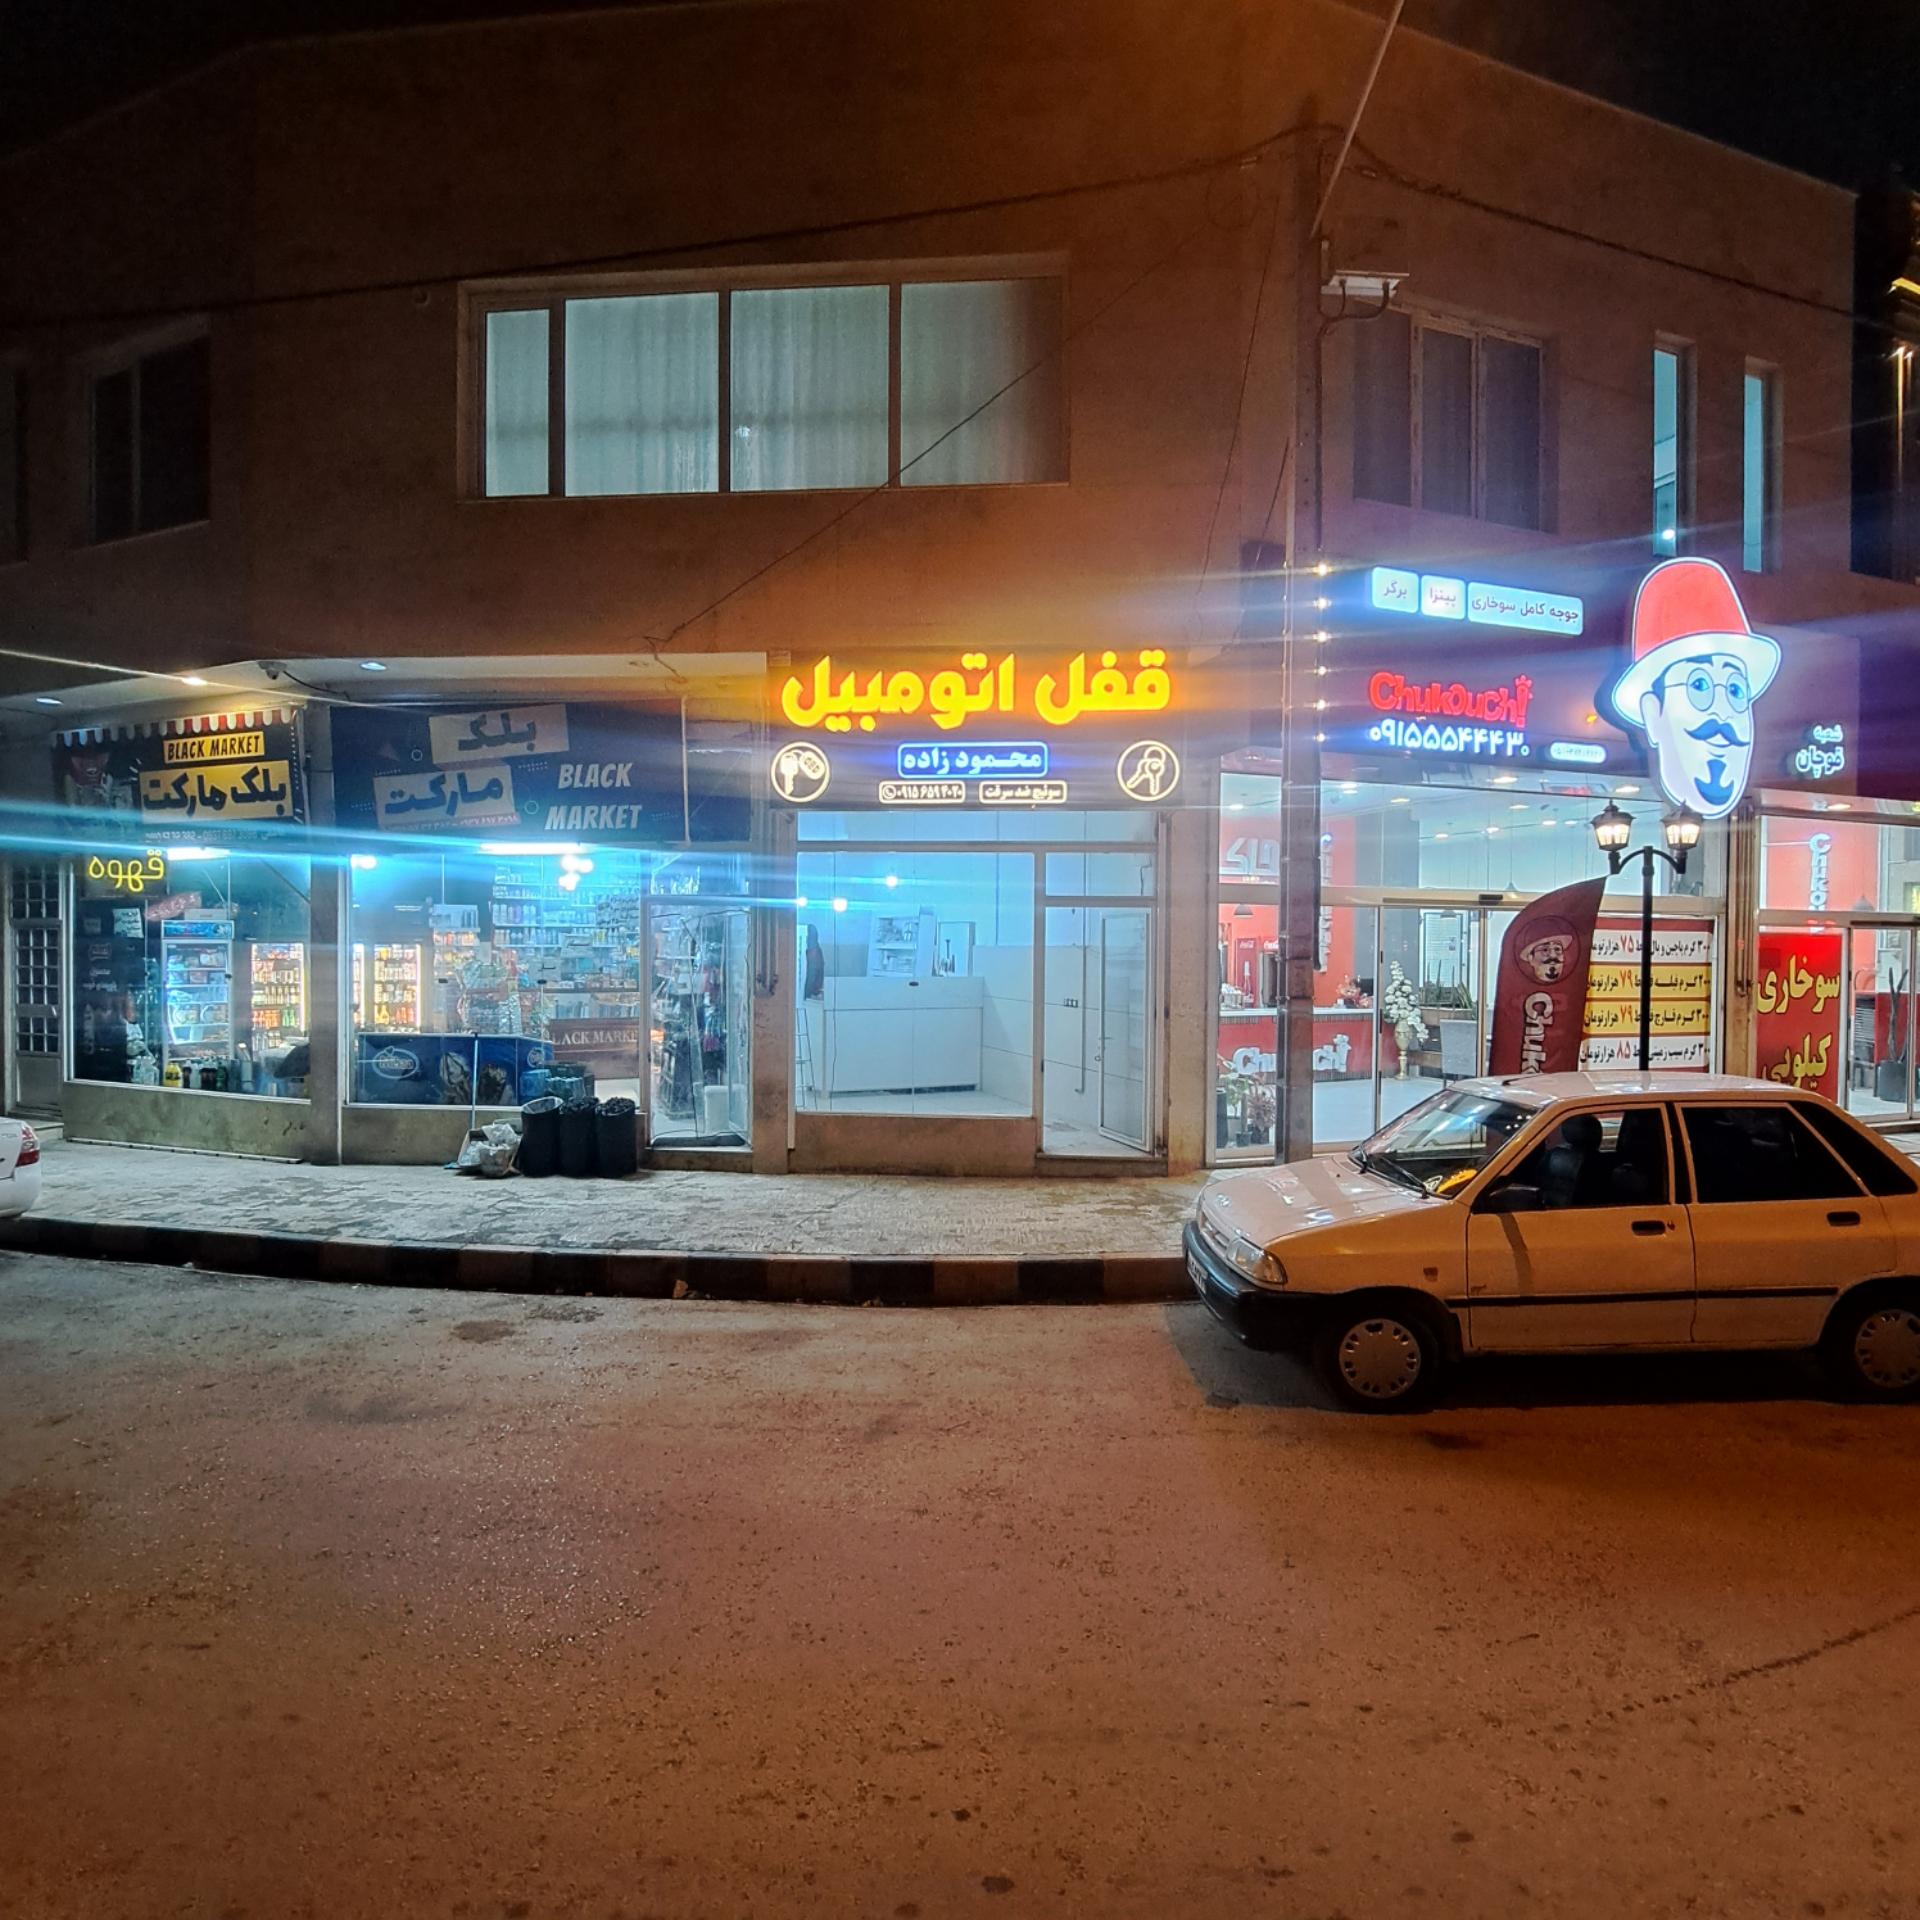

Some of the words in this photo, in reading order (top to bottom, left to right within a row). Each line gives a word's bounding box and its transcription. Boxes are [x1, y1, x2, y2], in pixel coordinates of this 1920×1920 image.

[1383, 580, 1407, 599] برگر
[1471, 595, 1517, 613] سوخاری
[1520, 602, 1545, 618] کامل
[1548, 608, 1579, 624] جوجه
[781, 652, 1015, 733] اتومبیل
[1034, 648, 1172, 726] قفل
[457, 712, 537, 752] بلک
[167, 741, 206, 761] BLACK
[210, 734, 260, 756] MARKET
[903, 747, 950, 775] زاده
[557, 761, 634, 789] BLACK
[955, 750, 1042, 775] محمود
[231, 766, 287, 816] بلک
[385, 770, 504, 818] مارکت
[544, 804, 643, 830] MARKET
[88, 849, 164, 892] قهوه
[1620, 933, 1635, 953] ۷۵
[1757, 954, 1840, 1014] سوخاری
